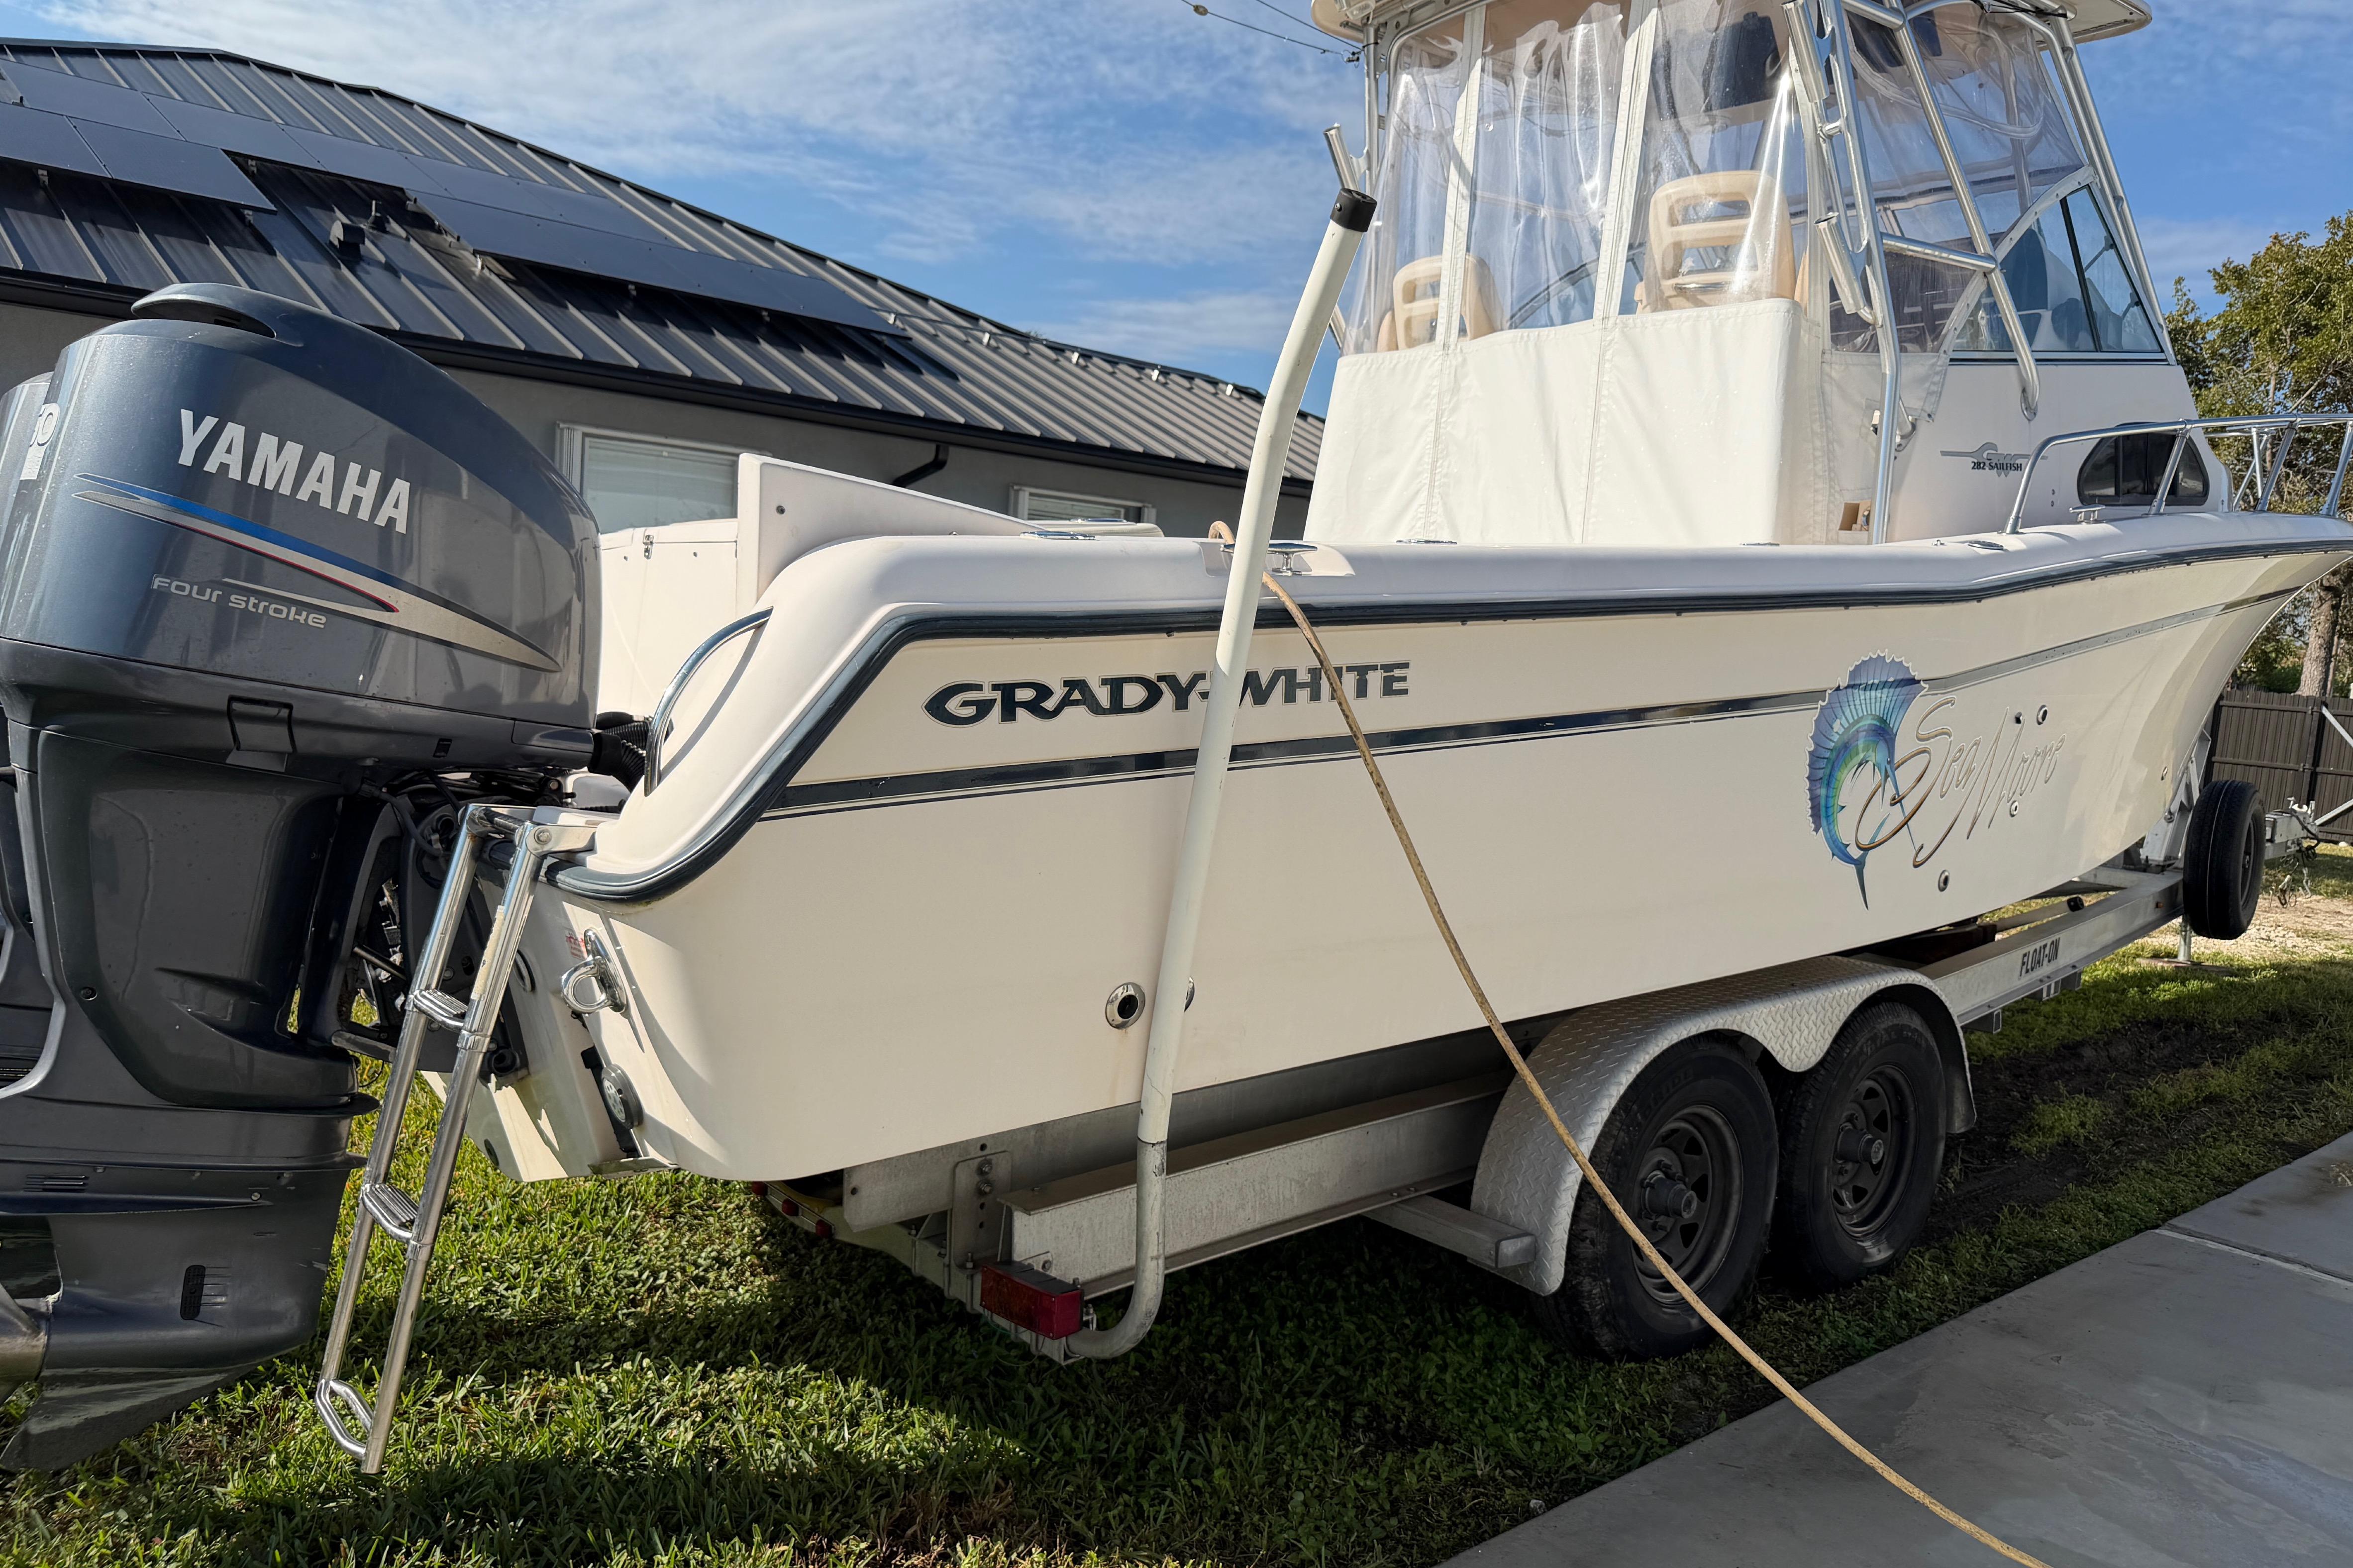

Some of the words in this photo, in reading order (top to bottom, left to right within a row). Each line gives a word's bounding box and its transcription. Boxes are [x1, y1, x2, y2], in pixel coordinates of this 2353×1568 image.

[178, 409, 410, 534] YAMAHA
[1971, 461, 1986, 470] 282
[1988, 462, 2022, 472] SAILFISH
[922, 661, 1410, 727] GRADY-WHITE
[1855, 696, 1981, 851] Sea
[2020, 937, 2060, 977] FLOAT-ON
